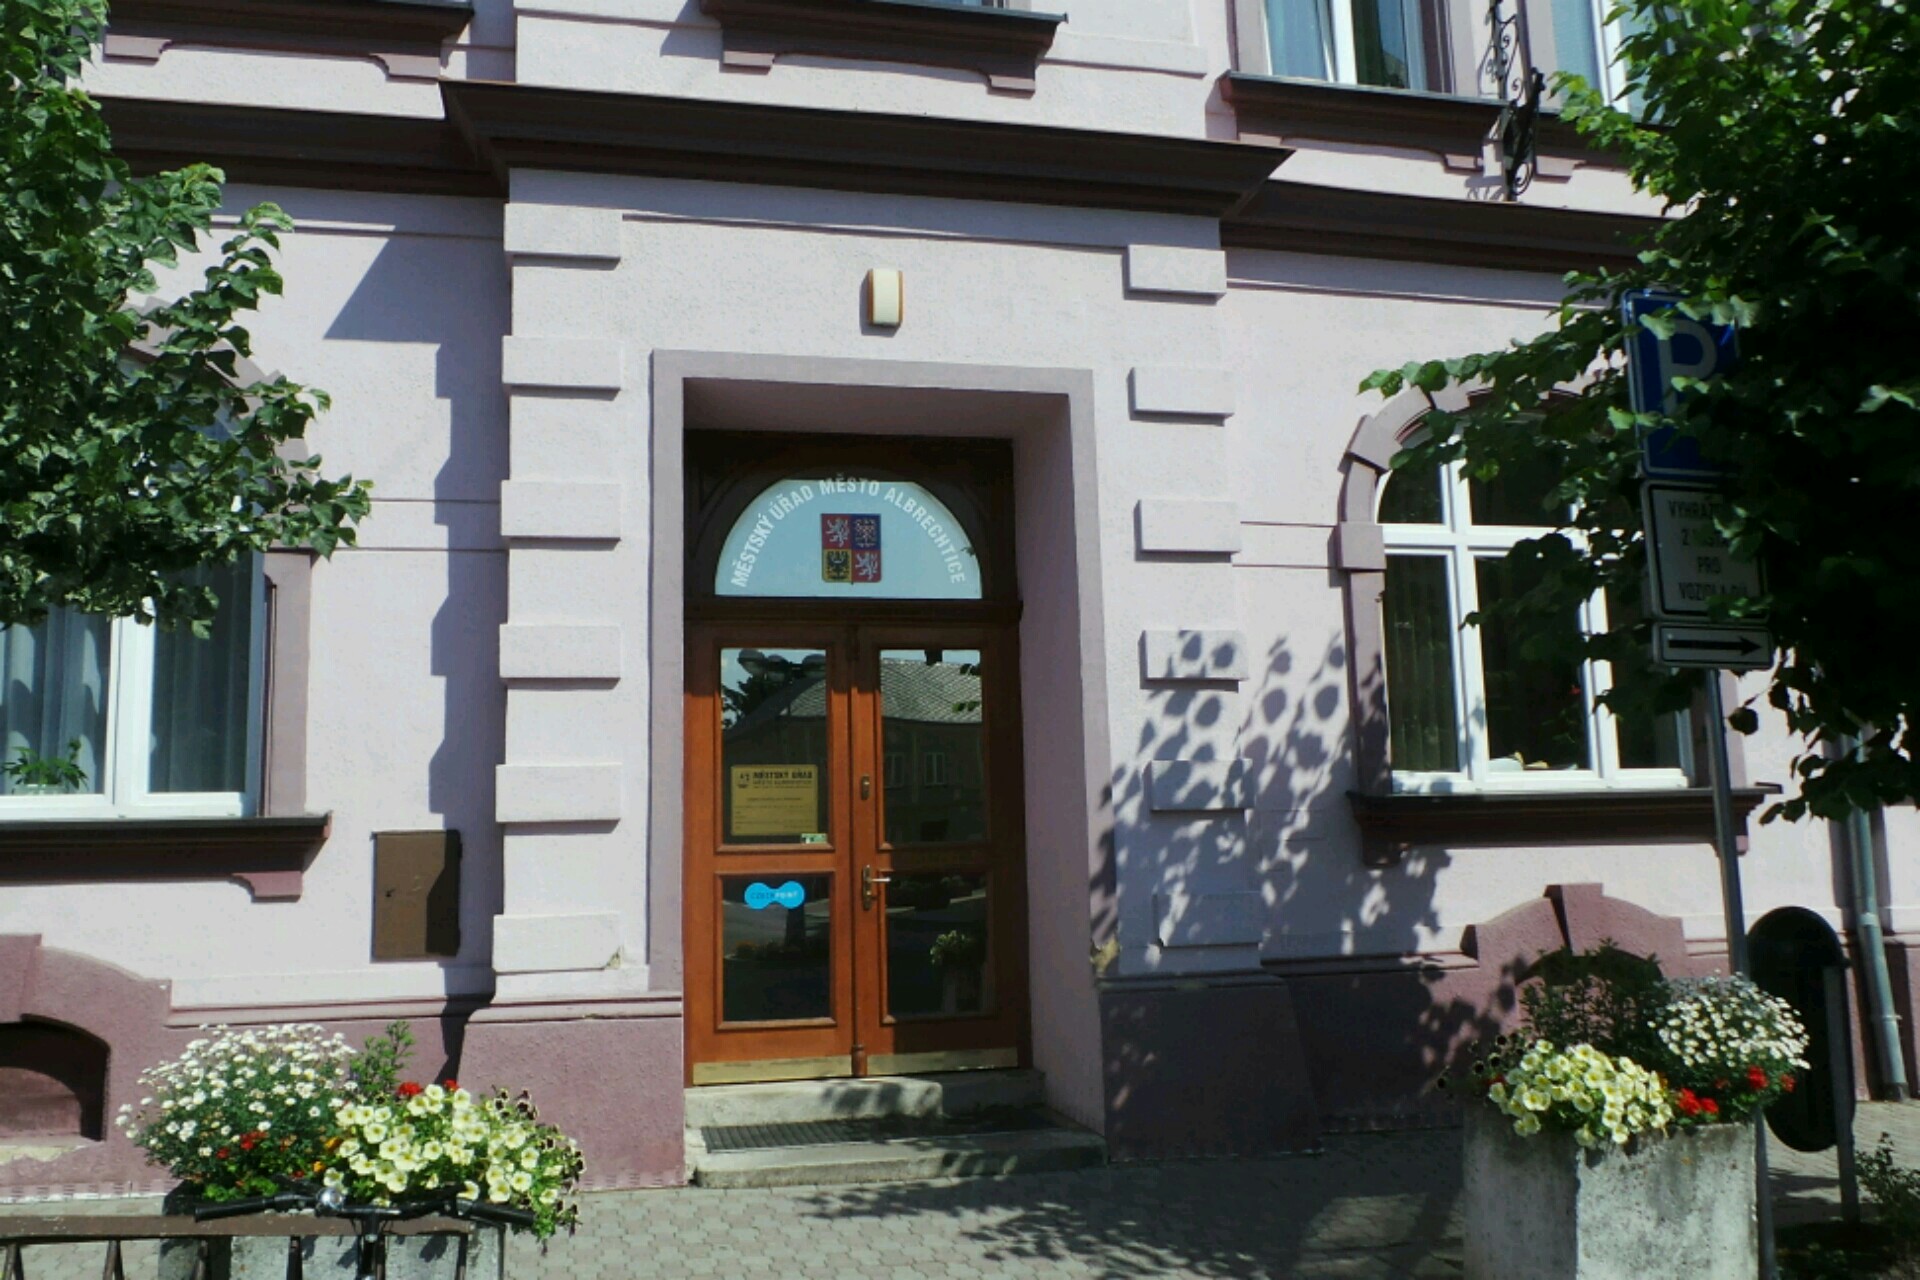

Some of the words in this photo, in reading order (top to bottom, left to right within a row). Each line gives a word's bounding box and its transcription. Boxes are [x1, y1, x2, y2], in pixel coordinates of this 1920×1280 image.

[1656, 318, 1718, 415] P
[730, 513, 774, 588] MĚSTSKÝ
[770, 484, 815, 522] ÚŘAD
[819, 472, 881, 497] MĚSTO
[884, 486, 966, 585] ALBRECHTICE
[1697, 556, 1721, 574] PRO
